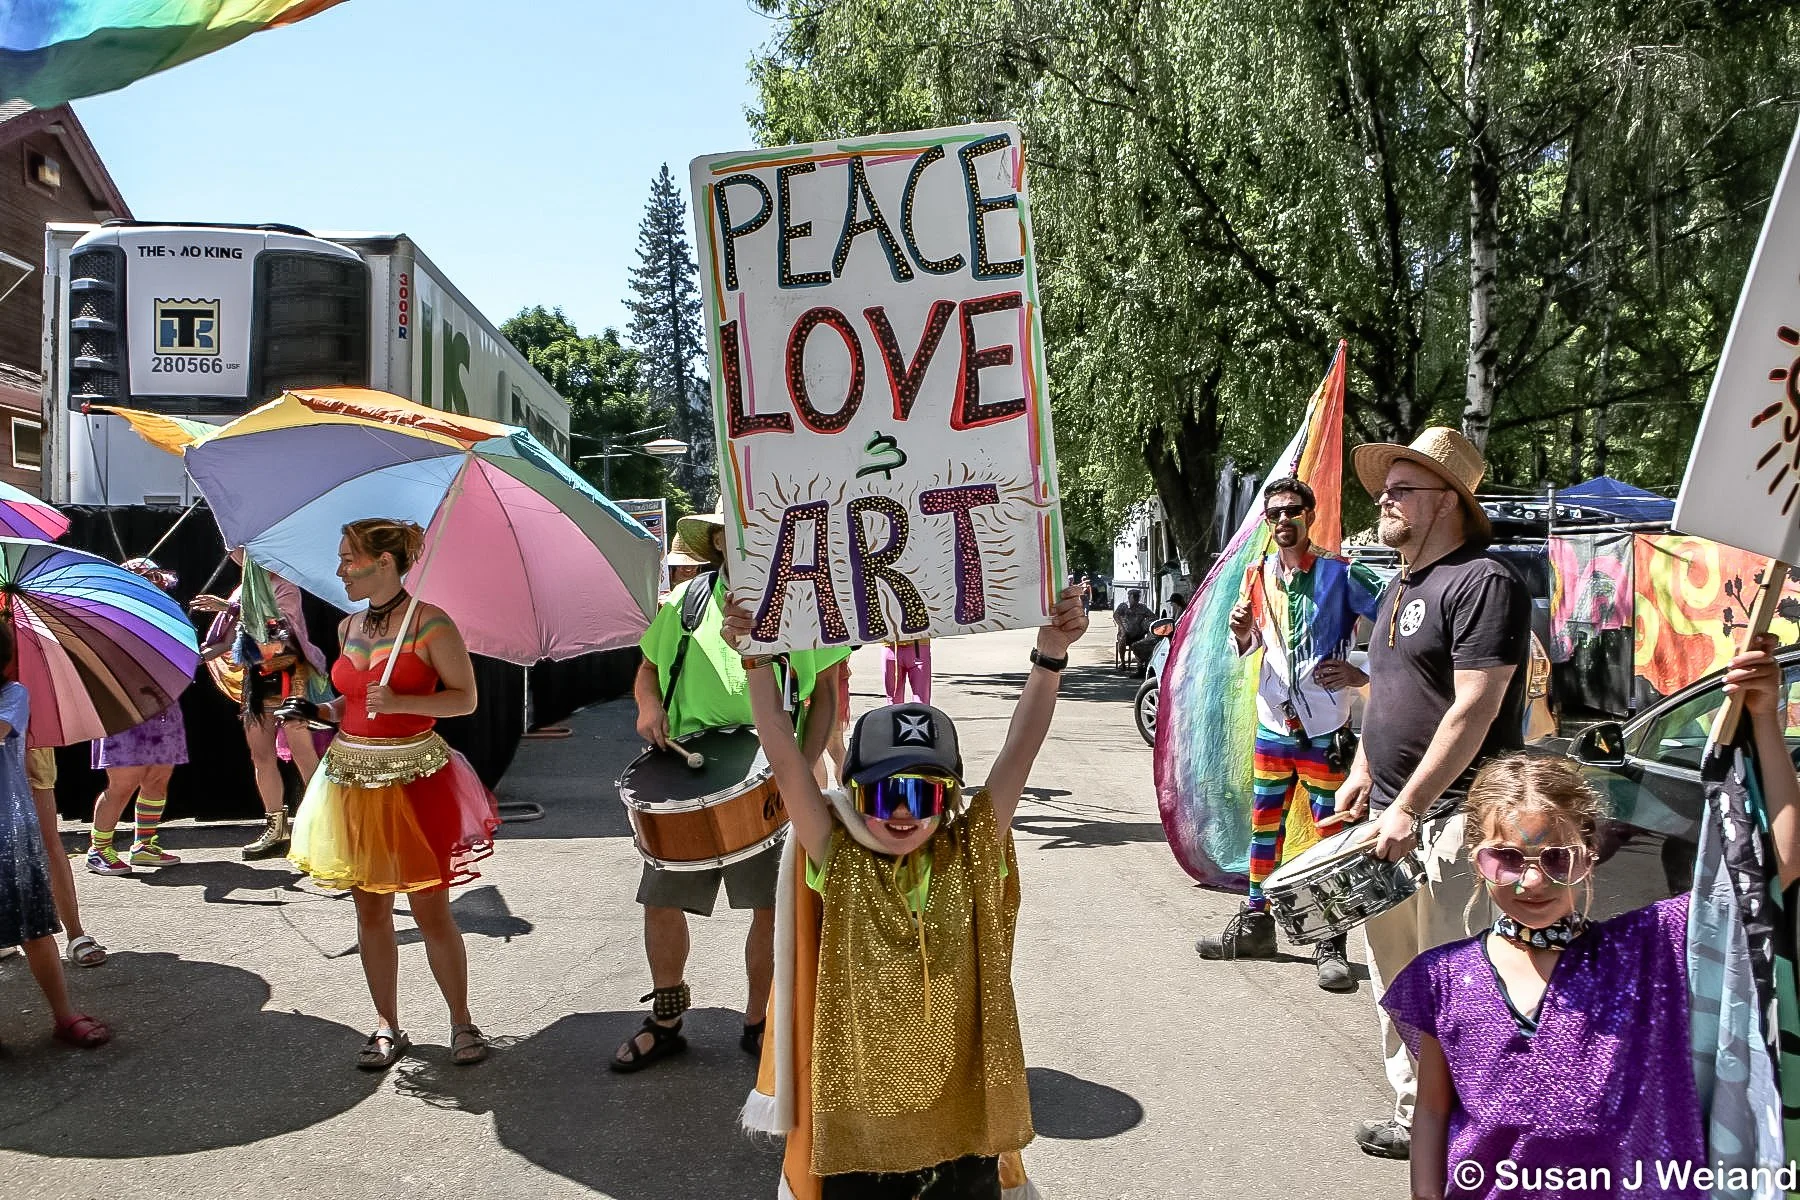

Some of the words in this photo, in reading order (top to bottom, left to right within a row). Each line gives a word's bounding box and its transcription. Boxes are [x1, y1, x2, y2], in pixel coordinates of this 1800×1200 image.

[138, 246, 201, 257] THEO
[204, 247, 242, 259] KING
[714, 134, 1024, 290] PEACE
[151, 357, 223, 373] 280566
[719, 291, 1026, 438] LOVE
[751, 484, 999, 643] ART
